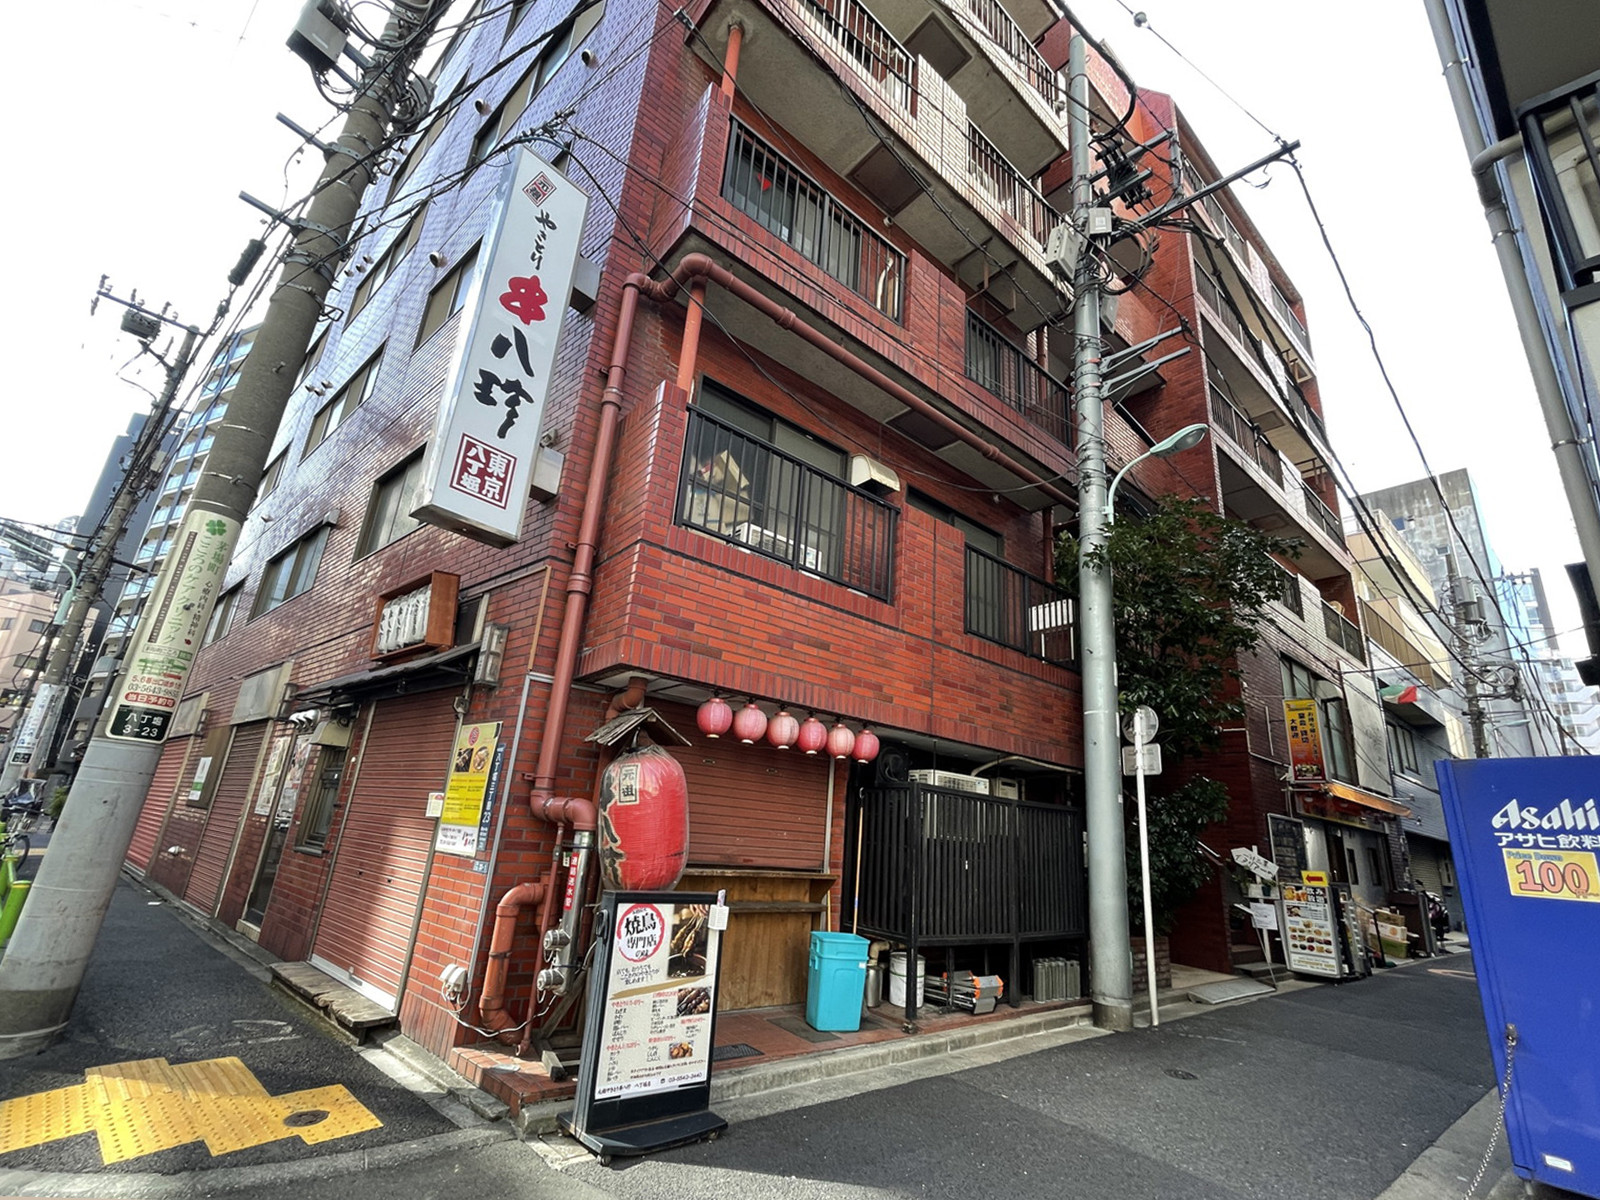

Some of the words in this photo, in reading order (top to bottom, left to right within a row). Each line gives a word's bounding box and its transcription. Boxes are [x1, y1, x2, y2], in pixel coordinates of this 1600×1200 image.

[530, 209, 557, 270] やきとり
[460, 445, 486, 495] 八丁堀
[482, 452, 507, 501] 東京
[207, 541, 229, 575] 茅場町
[163, 536, 212, 644] こころのケアクリニック
[127, 693, 174, 706] 当日予約可
[123, 724, 158, 737] 3-23
[125, 713, 163, 726] 八丁堀
[622, 769, 635, 797] 元祖
[482, 811, 491, 823] 23
[1491, 798, 1600, 831] Asahi
[1494, 832, 1600, 849] アサヒ飲料
[1307, 887, 1324, 895] 飲み
[1516, 860, 1589, 896] 100
[625, 912, 657, 936] 焼鳥
[627, 934, 657, 949] 専門店
